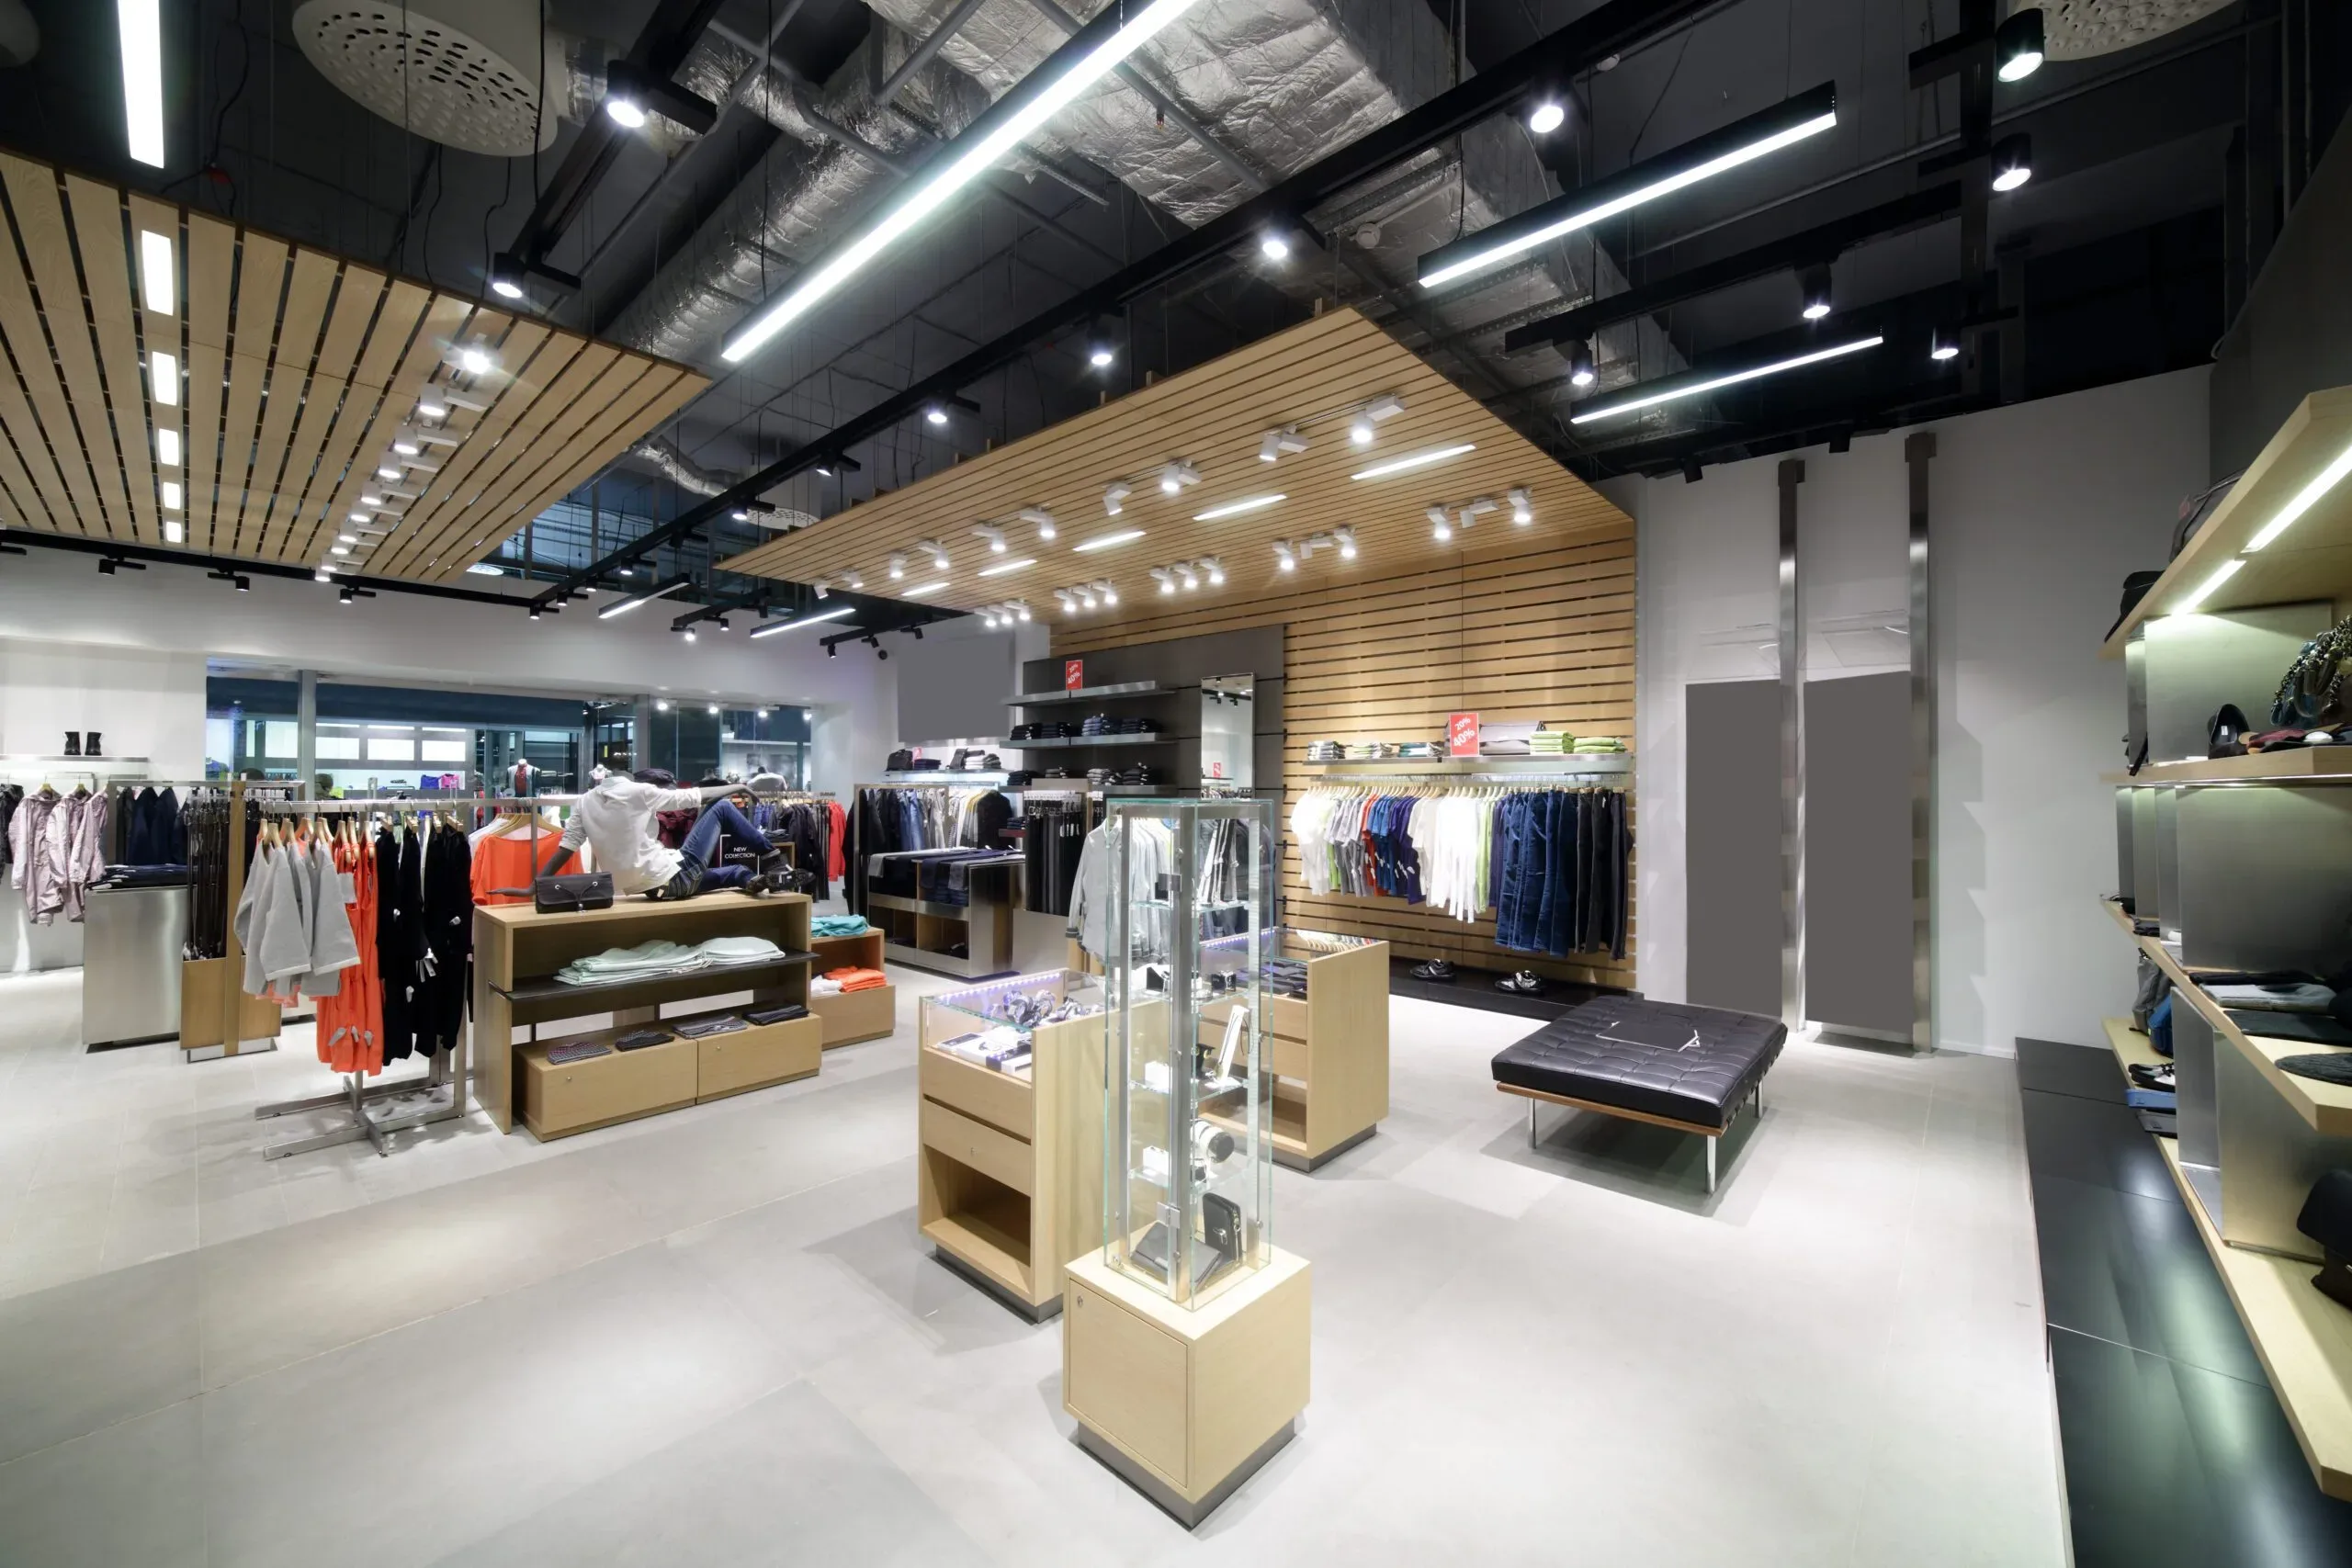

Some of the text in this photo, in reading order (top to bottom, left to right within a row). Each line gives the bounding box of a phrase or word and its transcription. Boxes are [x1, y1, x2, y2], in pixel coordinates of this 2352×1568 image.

[1068, 671, 1080, 684] 40%
[1454, 716, 1471, 731] 20%
[1453, 728, 1476, 747] 40%
